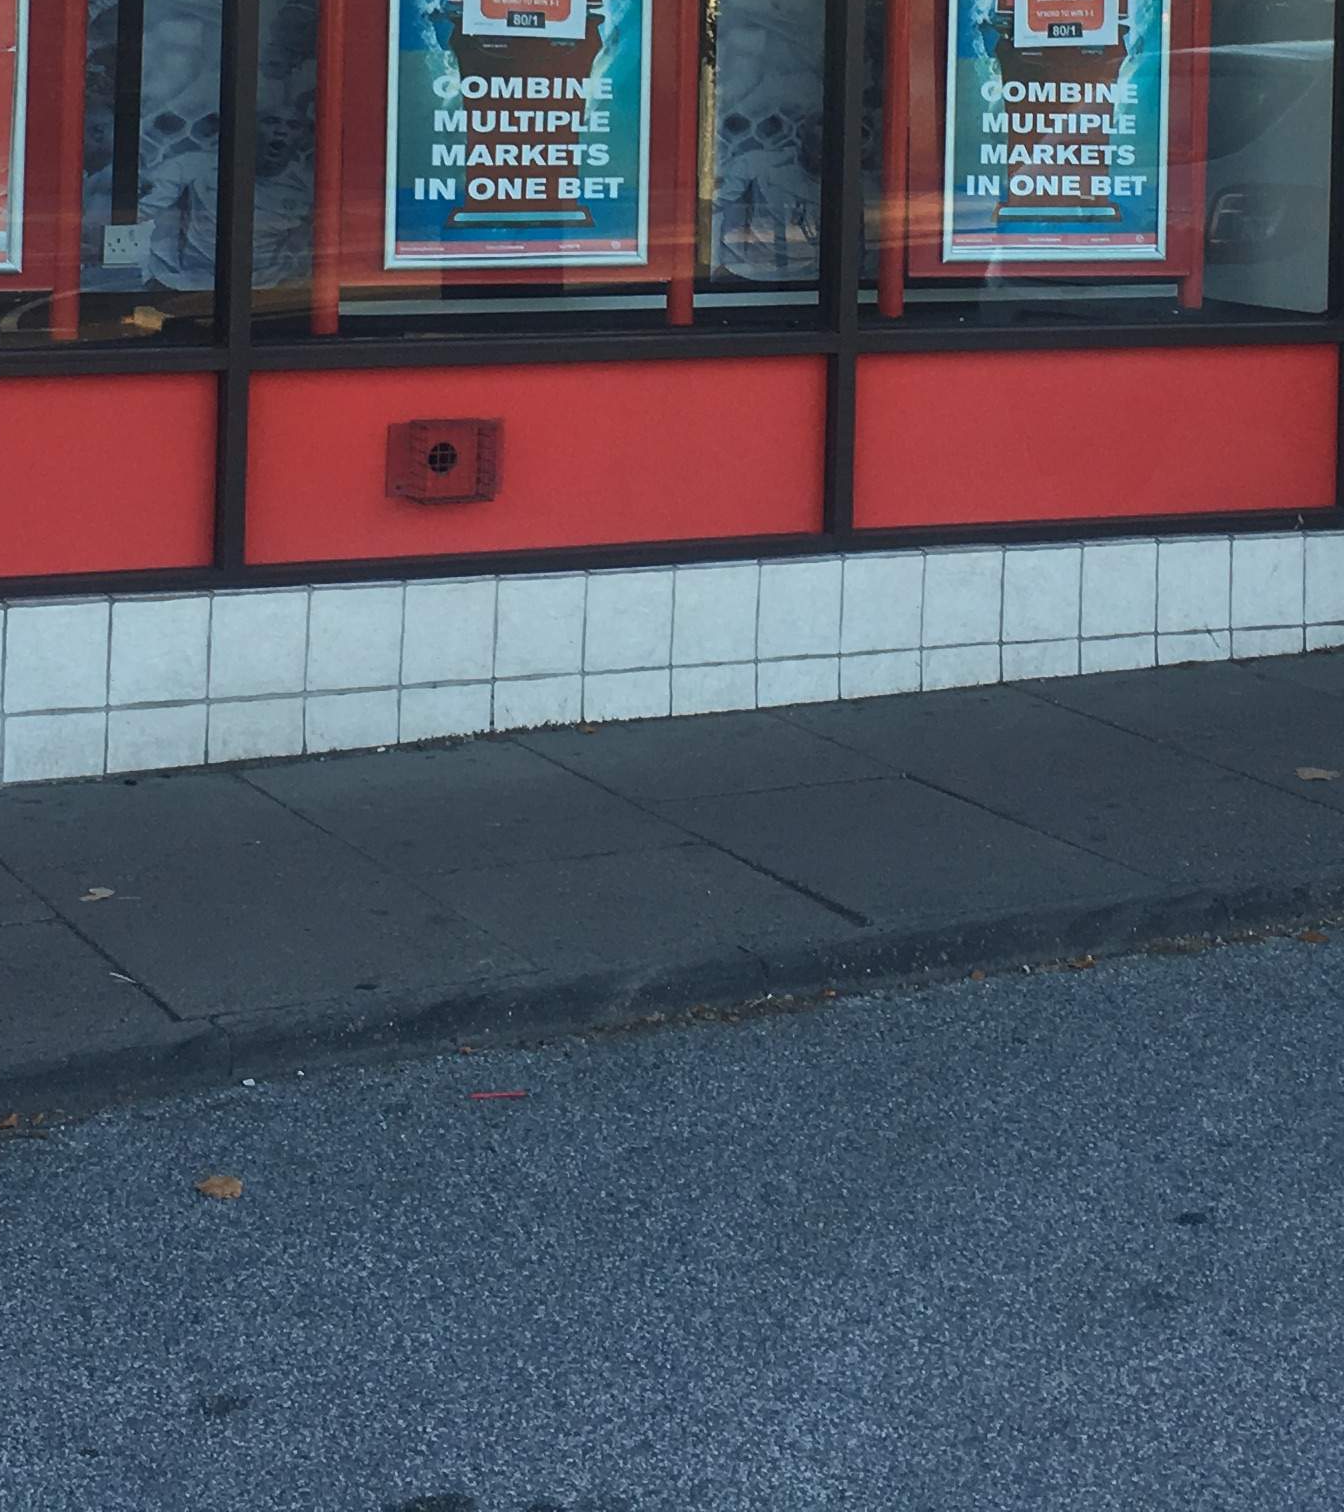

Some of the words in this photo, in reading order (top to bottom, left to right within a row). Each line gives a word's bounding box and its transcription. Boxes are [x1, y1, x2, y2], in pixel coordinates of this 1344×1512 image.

[513, 14, 538, 27] 80/1
[1052, 25, 1076, 37] 80/1
[432, 76, 613, 100] COMBINE
[980, 82, 1139, 104] COMBINE
[434, 110, 610, 133] MULTIPLE
[982, 113, 1136, 134] MULTIPLE
[431, 143, 610, 167] MARKETS
[980, 144, 1136, 165] MARKETS
[414, 177, 456, 200] IN
[468, 177, 548, 200] ONE
[558, 177, 624, 199] BET
[966, 175, 1000, 196] IN
[1010, 175, 1081, 196] ONE
[1091, 176, 1147, 196] BET
